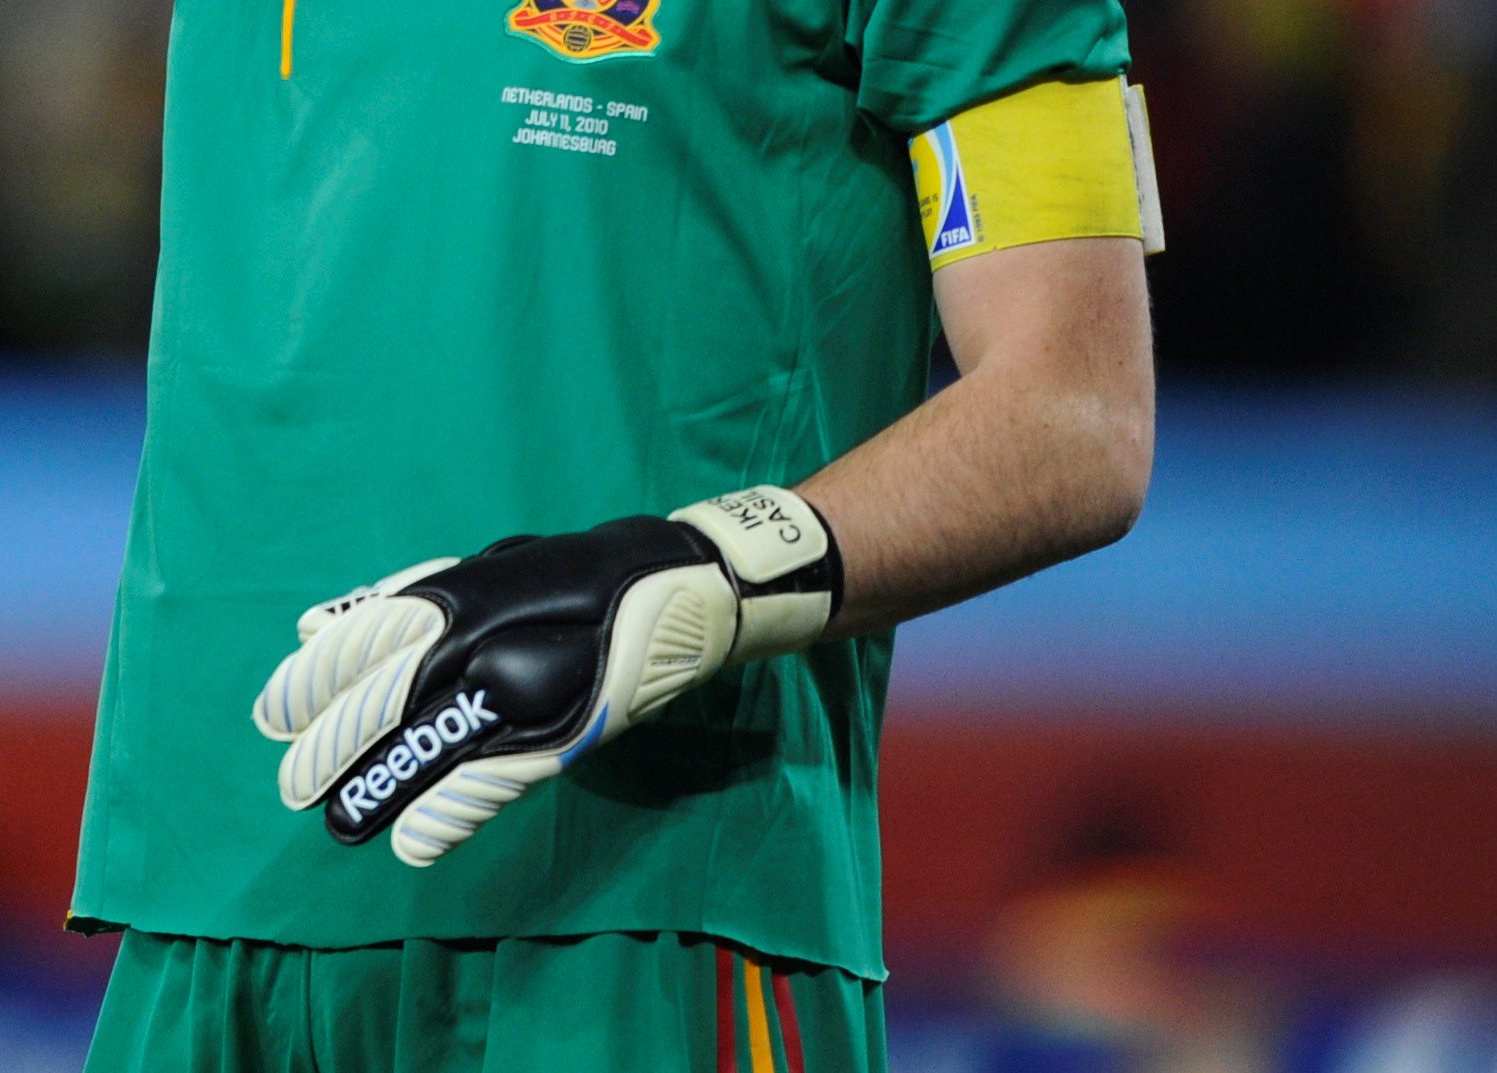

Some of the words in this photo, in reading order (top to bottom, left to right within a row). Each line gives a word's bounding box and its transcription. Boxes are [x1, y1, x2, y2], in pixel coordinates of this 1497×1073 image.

[502, 86, 593, 114] NETHERLANDS
[606, 101, 648, 122] SPAIN
[525, 109, 558, 127] JULY
[575, 116, 609, 136] 2010
[512, 128, 617, 156] JOHANNESBURG
[940, 226, 970, 249] FIFA
[340, 689, 499, 823] Reebok
